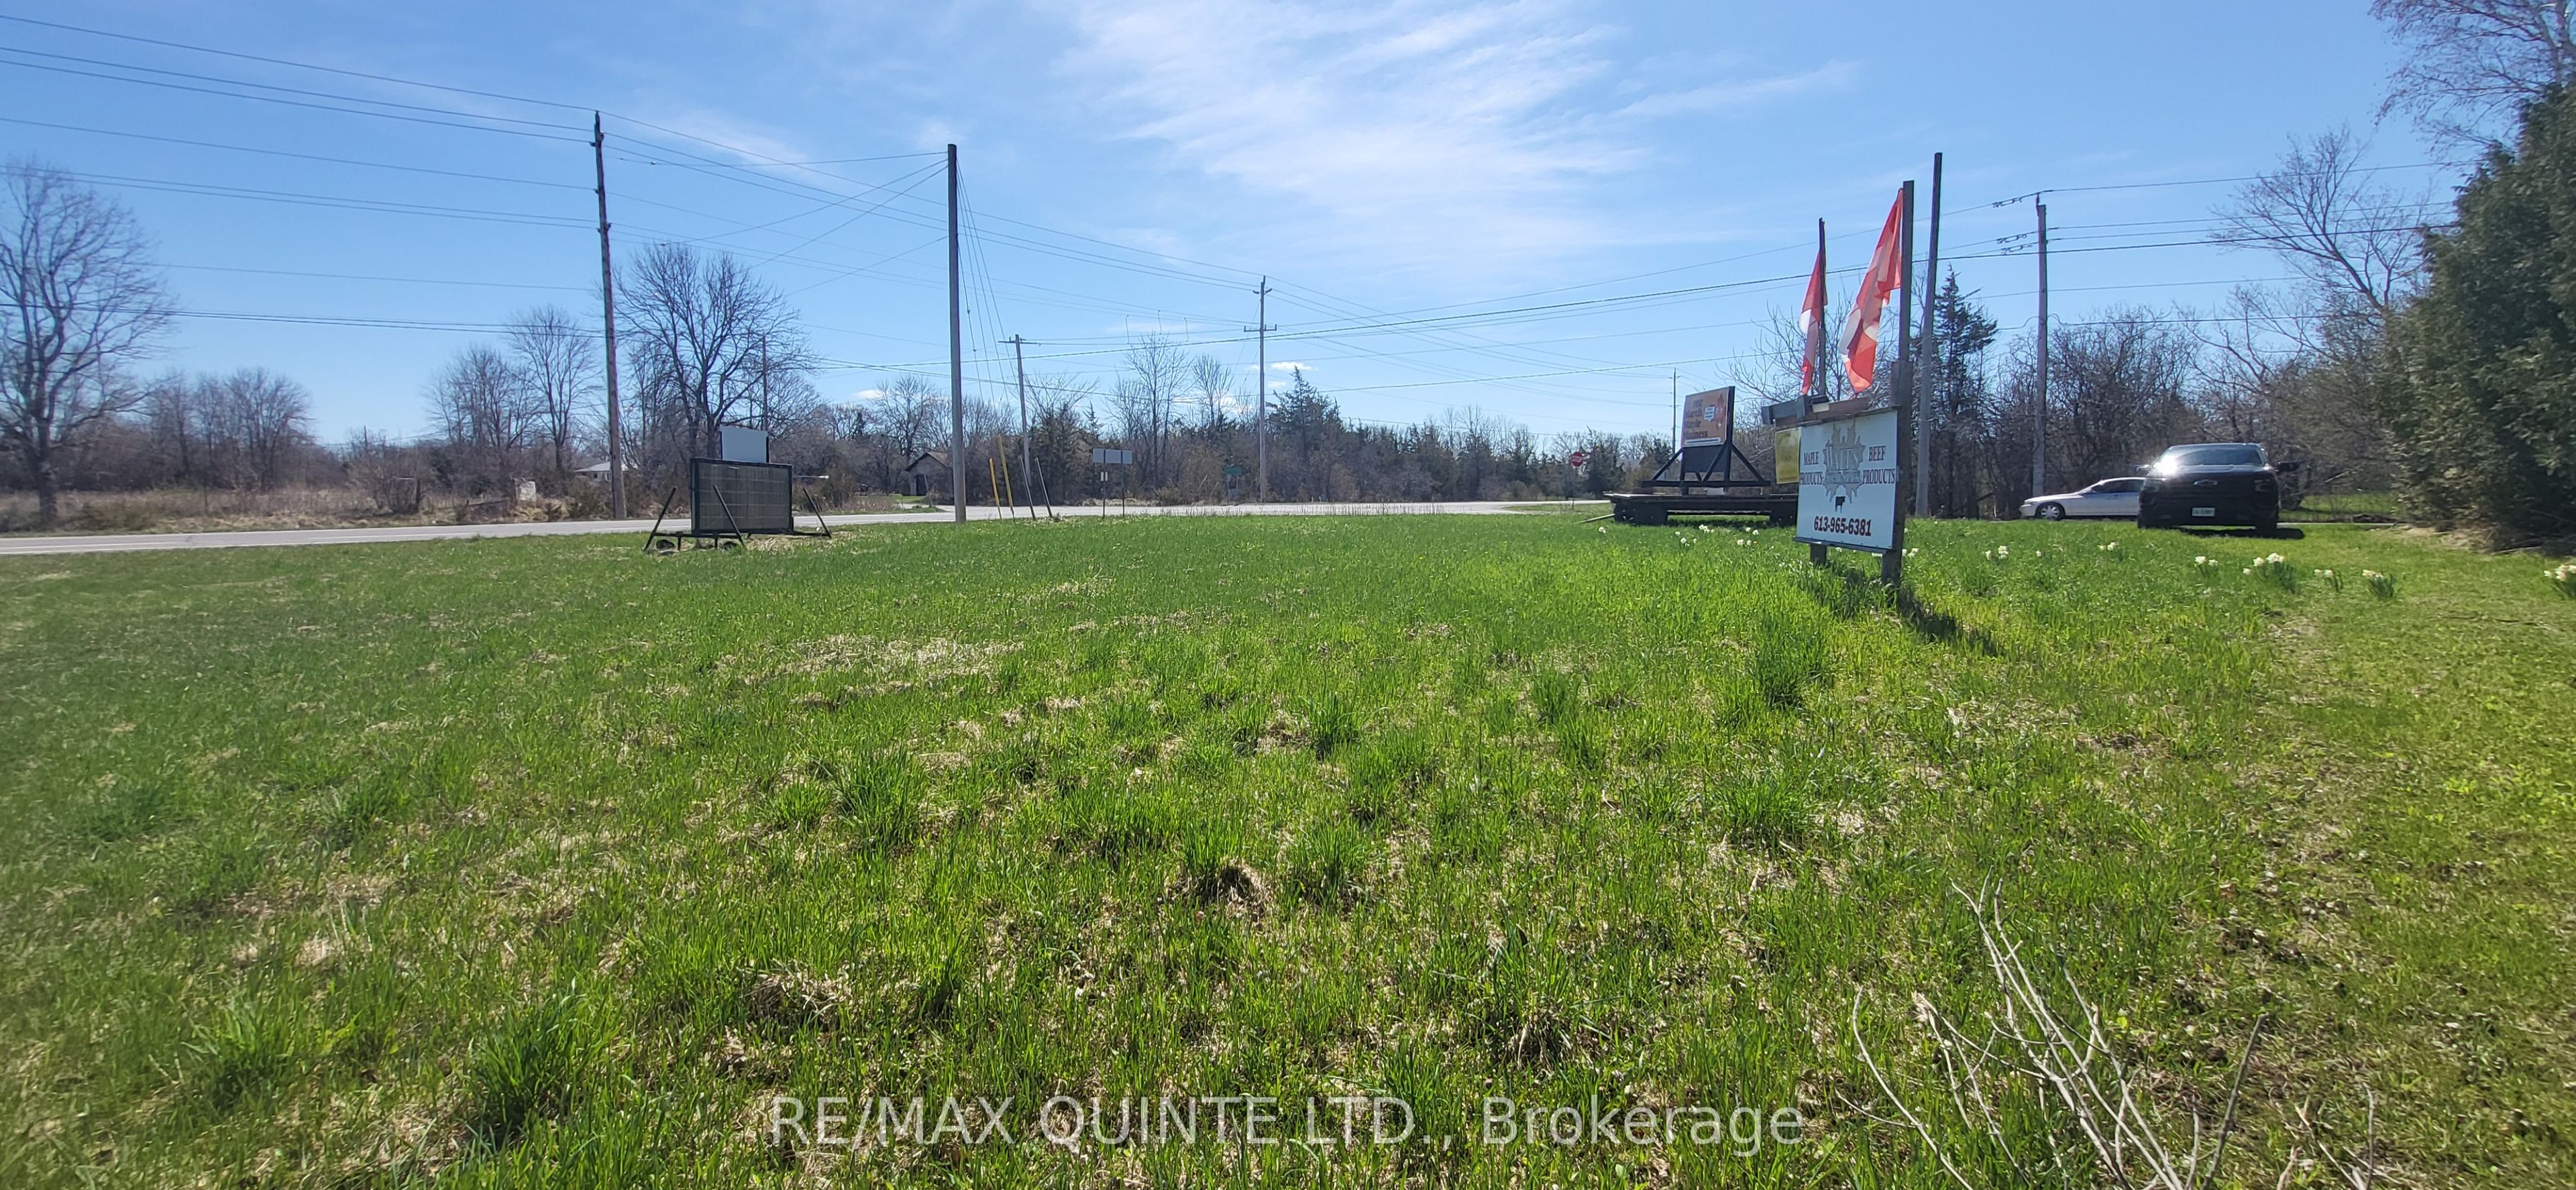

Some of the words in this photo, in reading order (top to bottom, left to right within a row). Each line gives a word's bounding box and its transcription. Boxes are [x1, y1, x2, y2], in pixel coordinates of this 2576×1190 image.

[1803, 451, 1819, 465] MAPLE
[1869, 446, 1885, 461] BEEF
[1799, 472, 1823, 485] PRODUCTS
[1862, 468, 1895, 484] PRODUCTS
[1814, 516, 1872, 537] 613-965-6381
